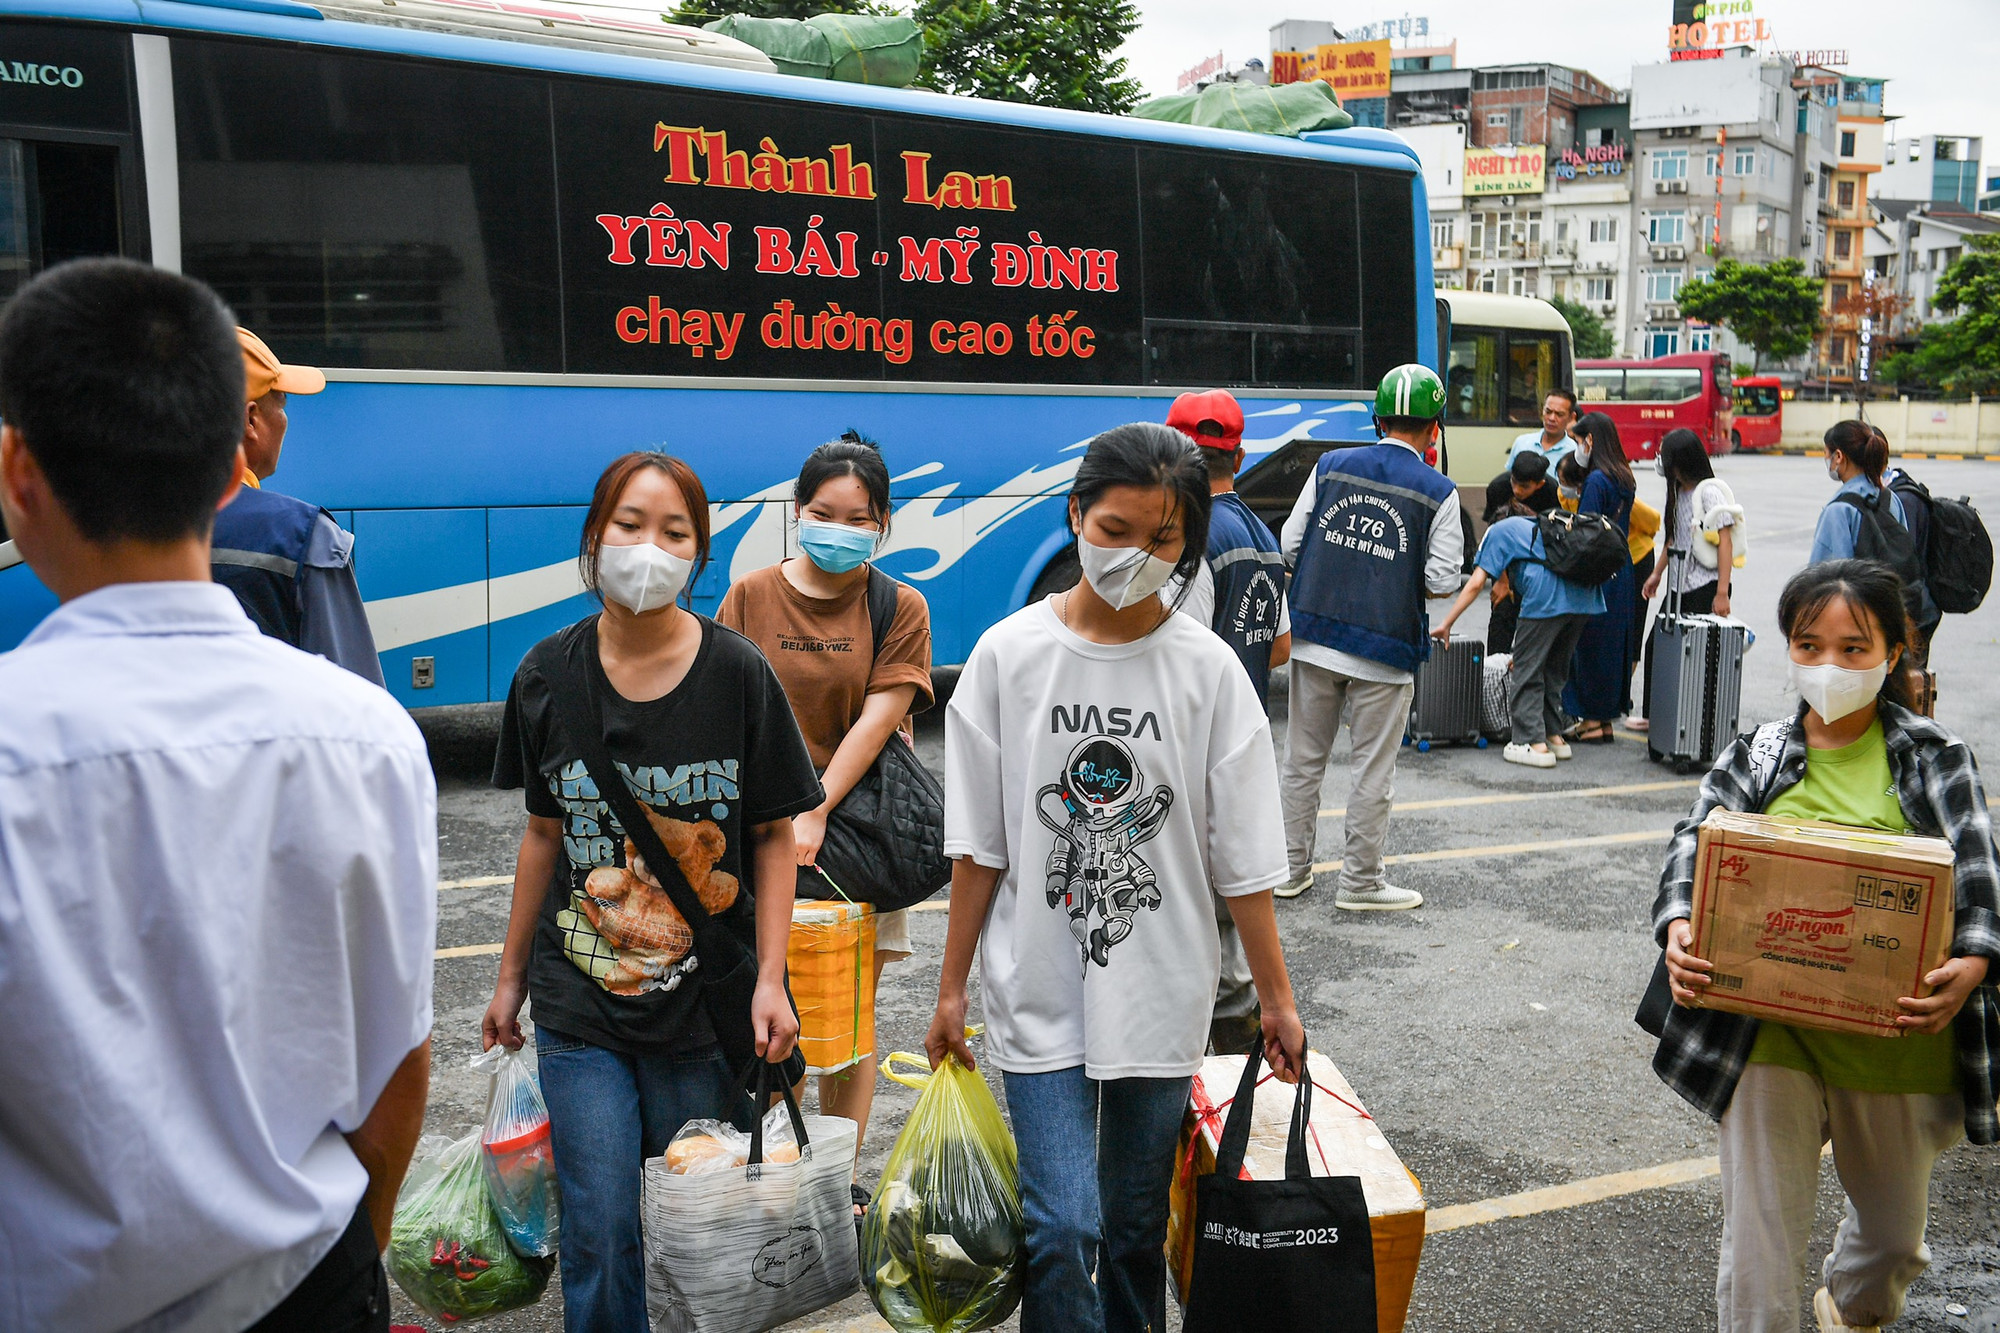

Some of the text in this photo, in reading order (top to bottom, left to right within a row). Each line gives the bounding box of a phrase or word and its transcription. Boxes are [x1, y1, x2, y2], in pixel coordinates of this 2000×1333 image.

[1668, 18, 1771, 48] HOTEL
[1274, 55, 1300, 84] BIA
[1807, 50, 1848, 66] HOTEL
[653, 120, 1017, 212] Thành Lan
[1509, 154, 1542, 178] TRỌ
[596, 202, 732, 271] YÊN
[754, 214, 860, 279] BÁI
[898, 226, 980, 285] MỸ
[990, 231, 1120, 292] ĐÌNH
[615, 296, 1097, 364] chạy đường cao tốc
[1324, 504, 1340, 520] DỊCH
[1338, 498, 1348, 509] VỤ
[1348, 493, 1363, 505] VẬN
[1346, 513, 1386, 539] 176
[1324, 529, 1396, 561] BẾN XE MỸ ĐÌNH
[781, 640, 853, 653] BEIJI&BYWZ.
[1051, 704, 1162, 741] NASA
[1863, 933, 1900, 951] HEO
[1761, 951, 1785, 963] CÔNG
[1785, 955, 1807, 968] NGHỆ
[1807, 959, 1830, 971] NHẬT
[1295, 1227, 1339, 1246] 2023
